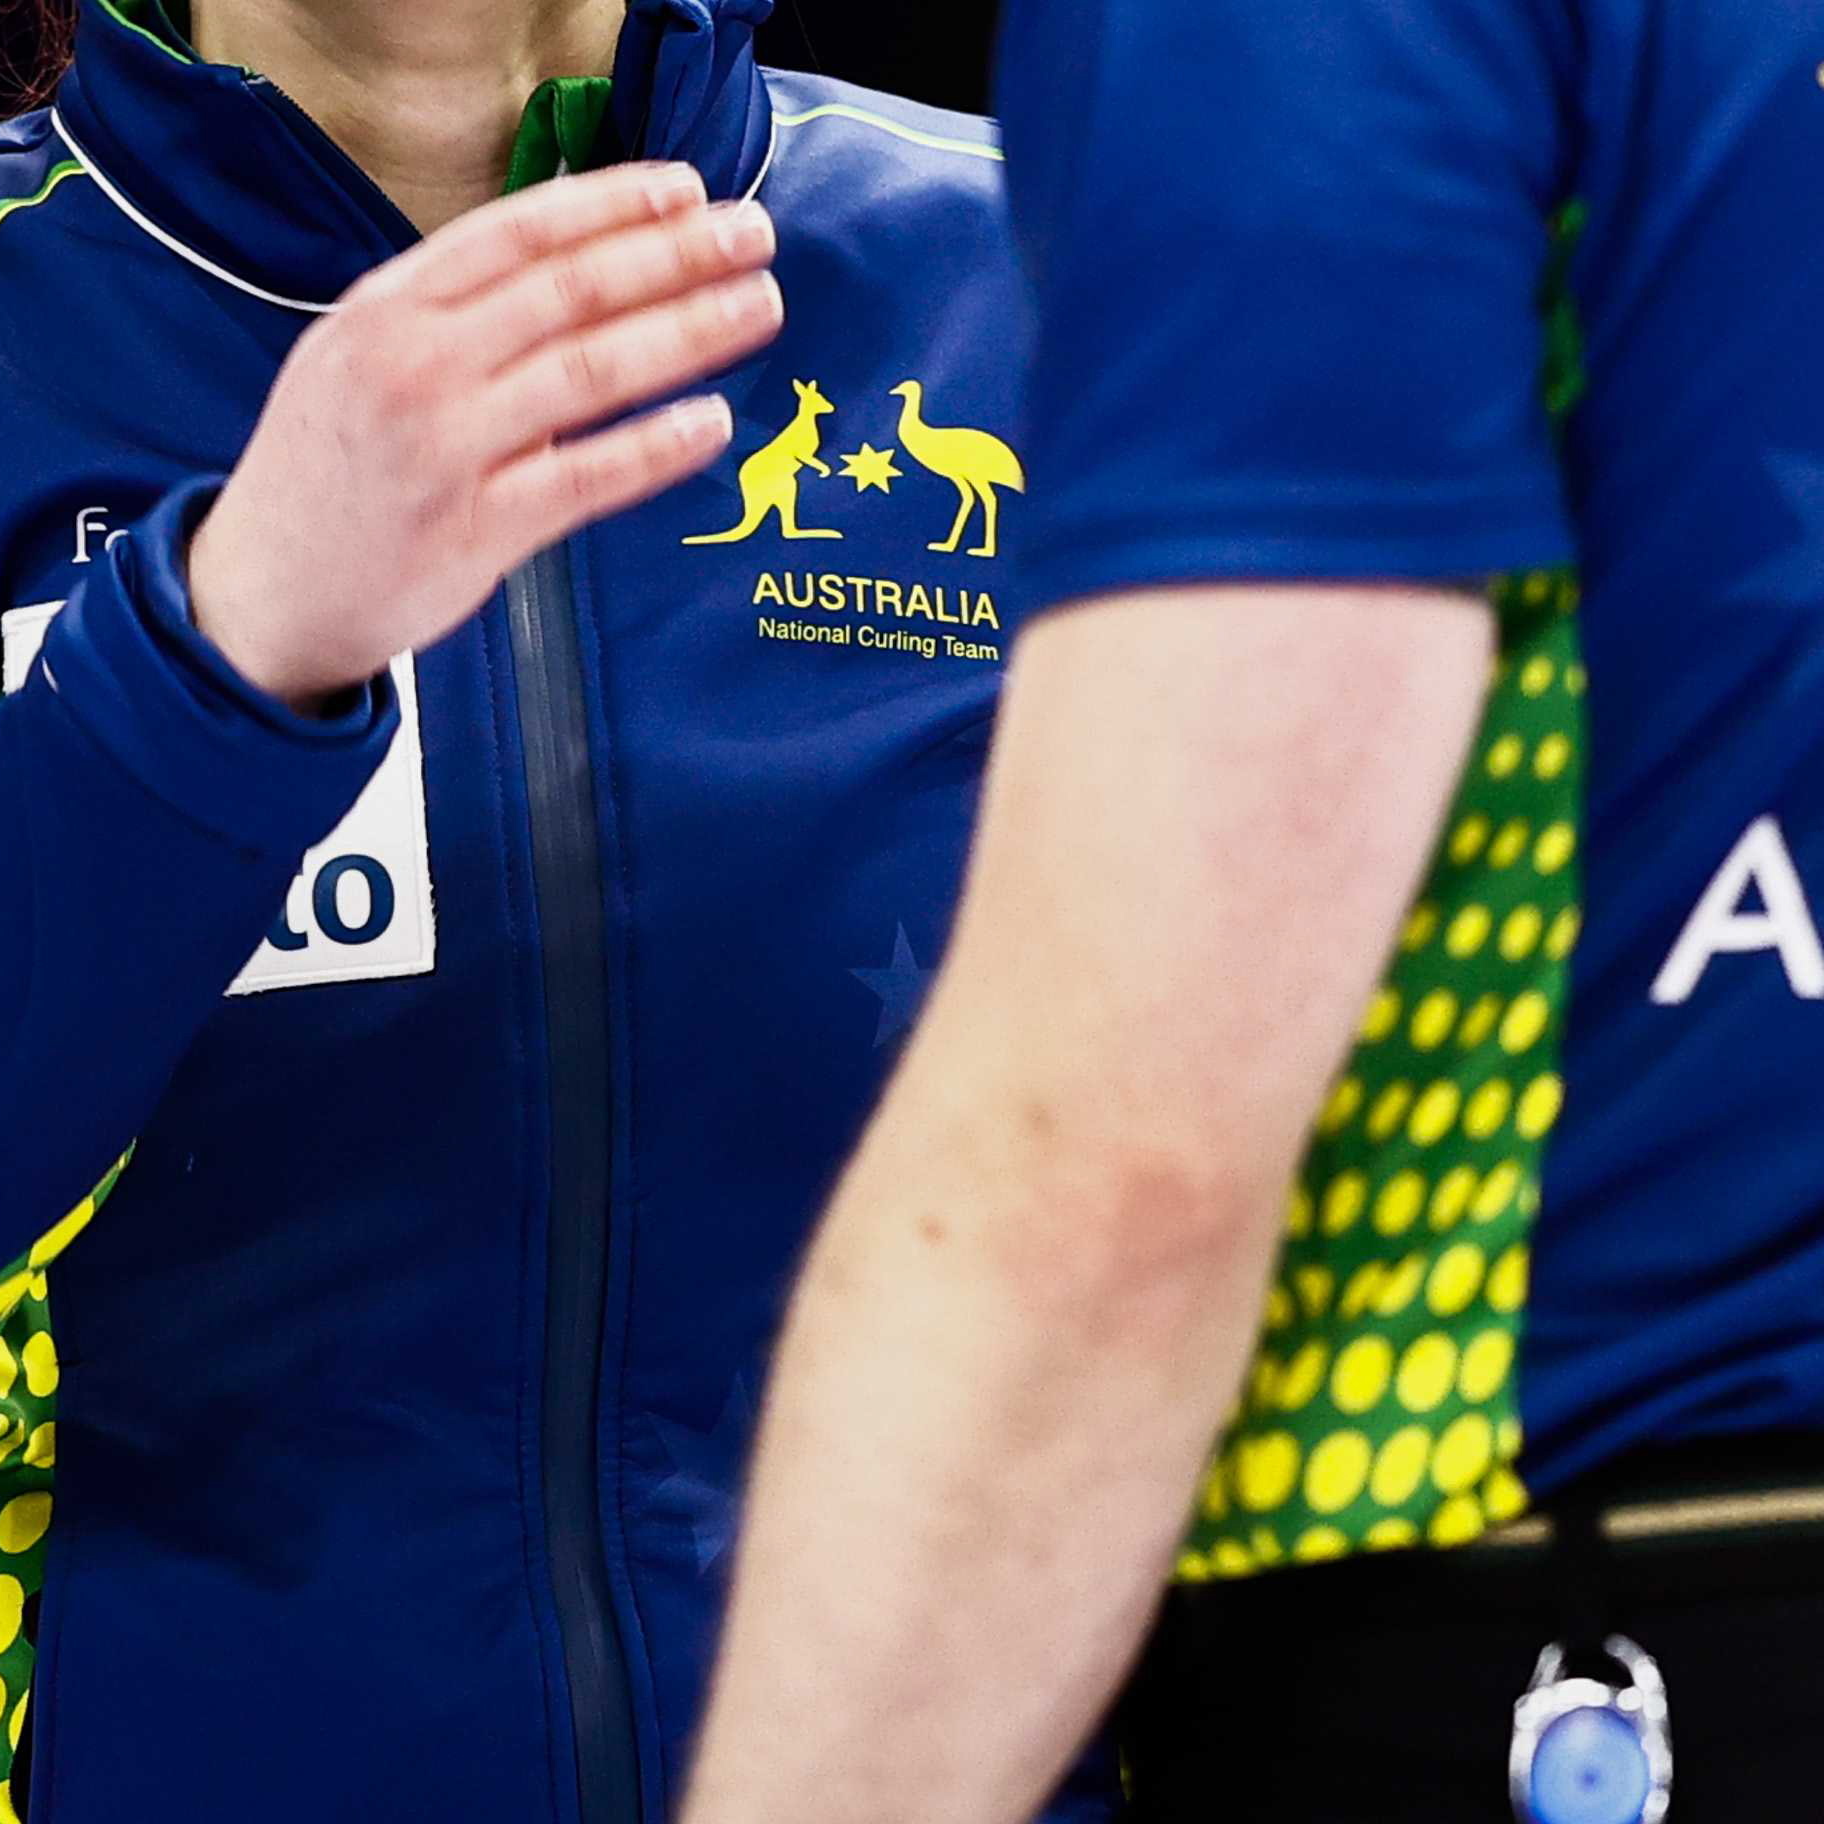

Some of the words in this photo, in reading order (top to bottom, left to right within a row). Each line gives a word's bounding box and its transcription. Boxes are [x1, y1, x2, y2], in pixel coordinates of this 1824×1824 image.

[752, 571, 1001, 631] AUSTRALIA
[758, 616, 851, 646] National
[857, 625, 937, 659] Curling
[942, 635, 1000, 662] Team
